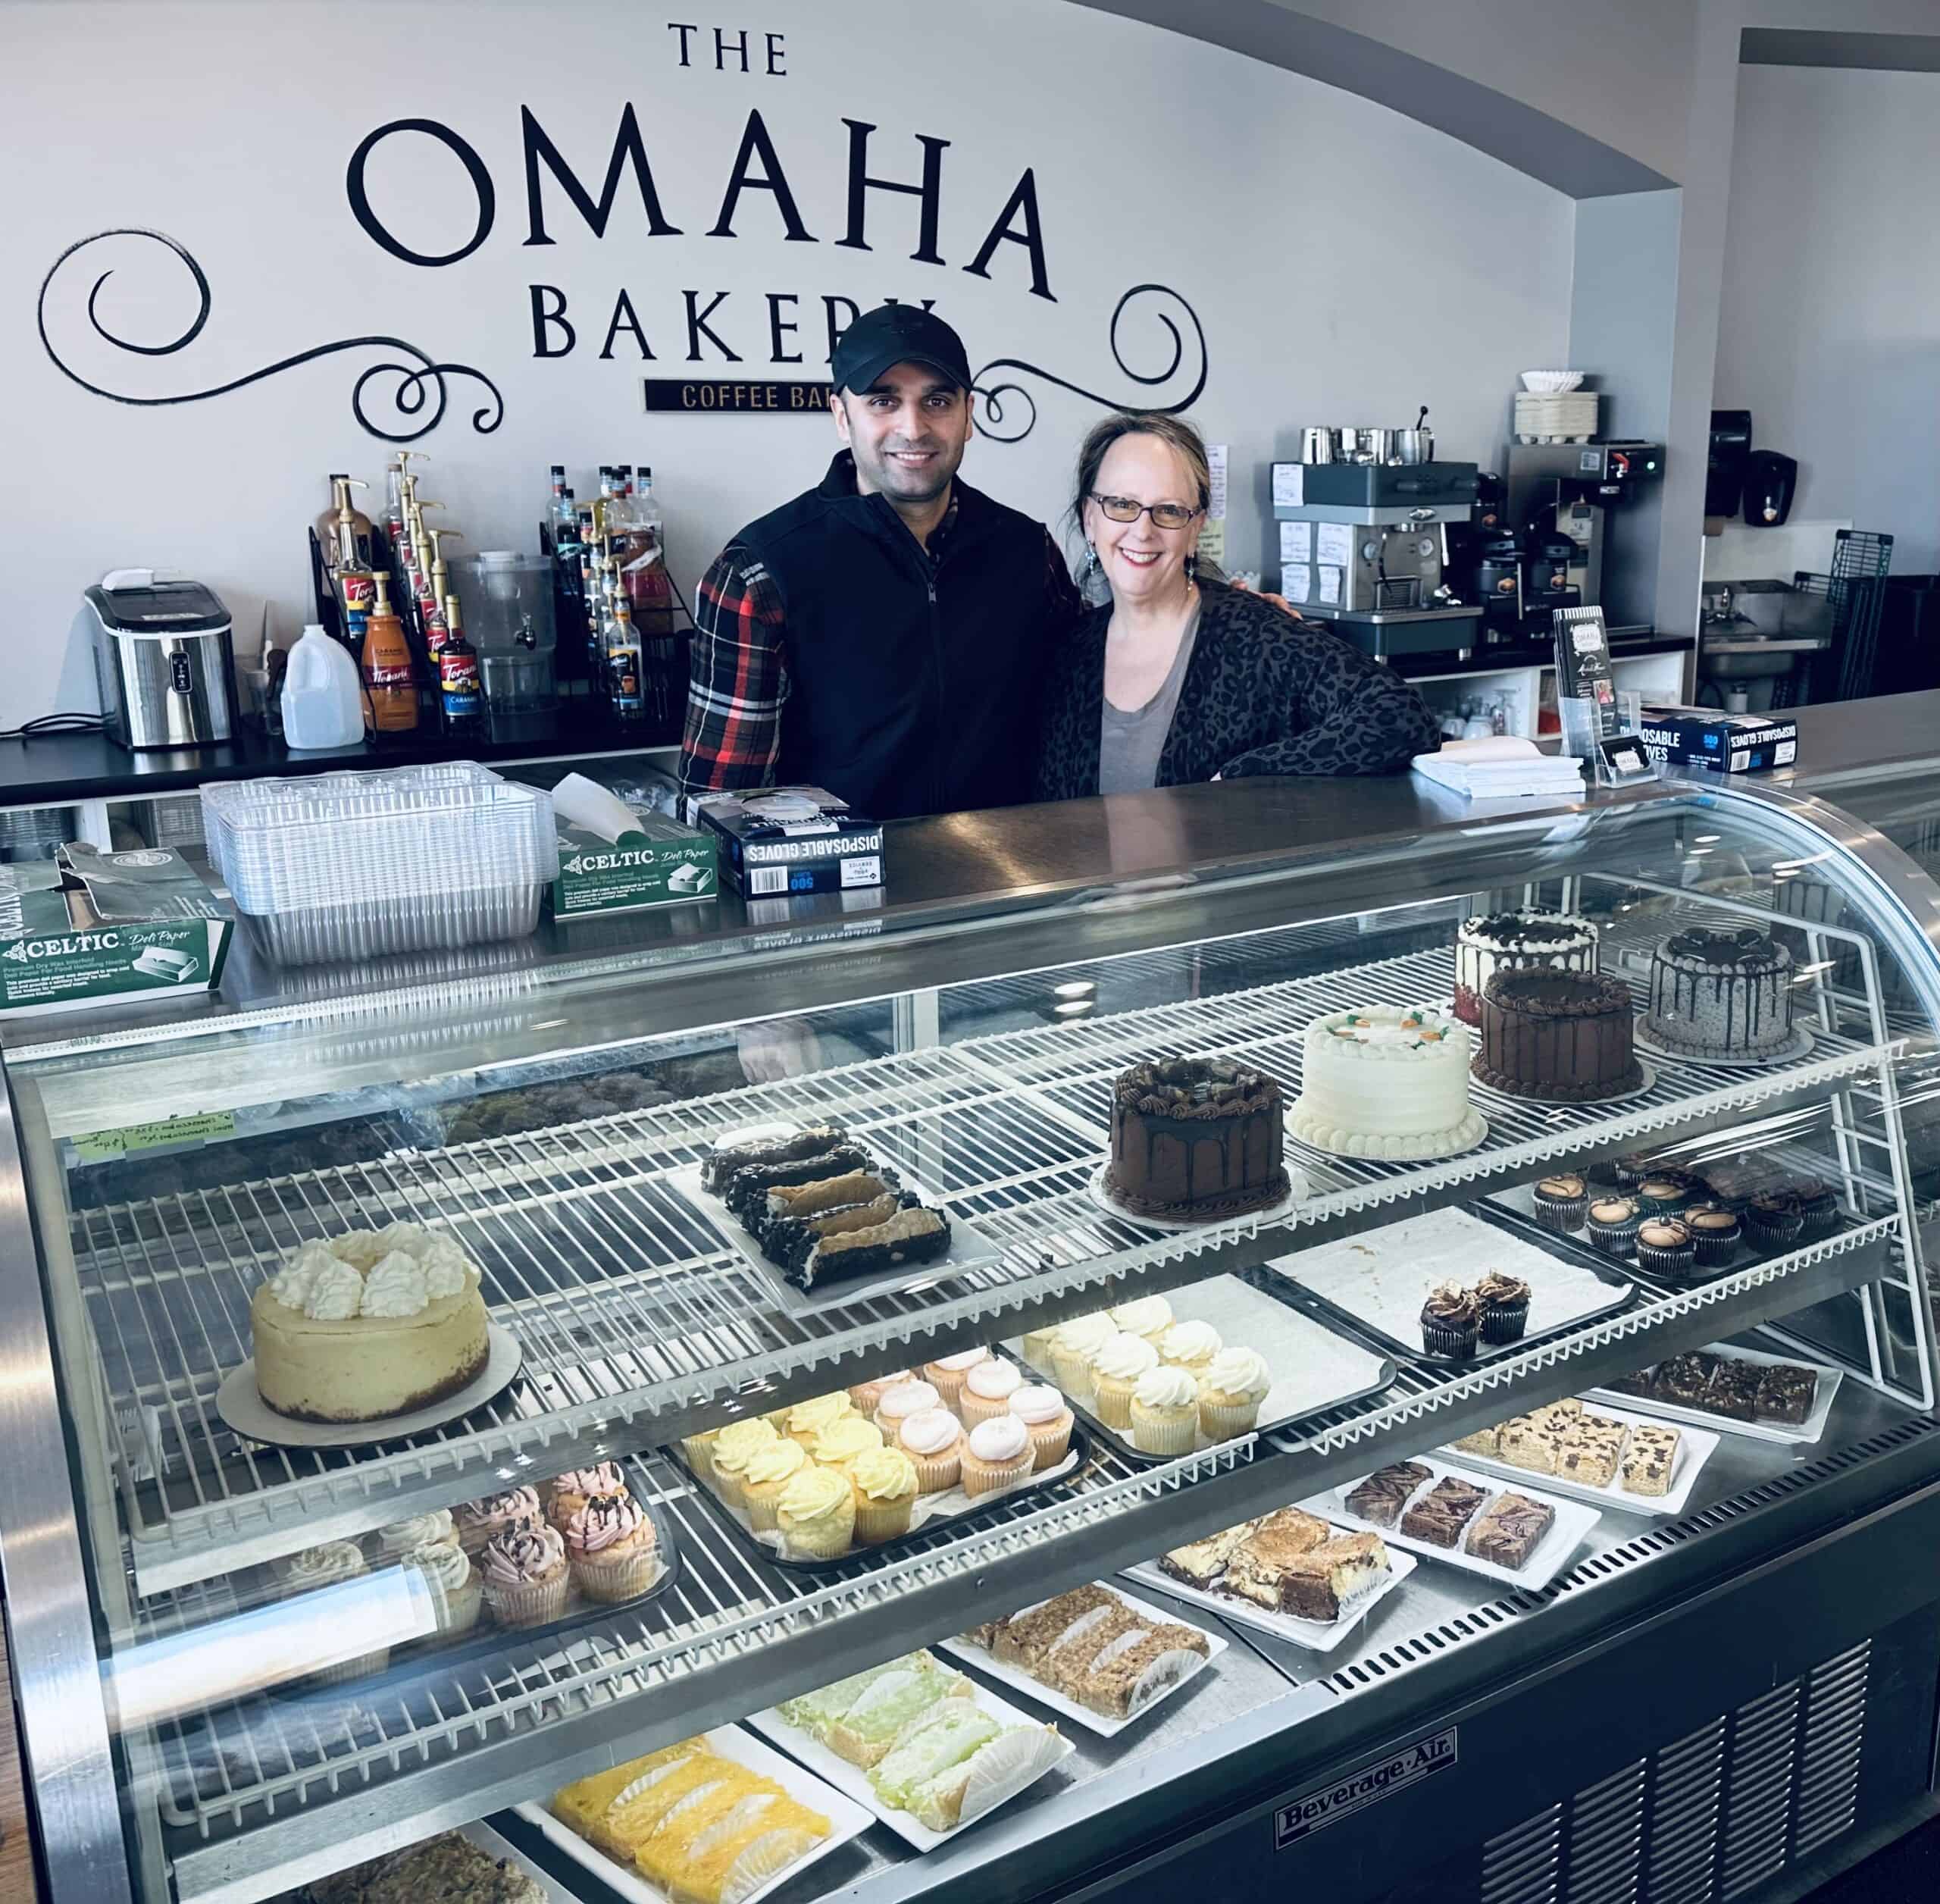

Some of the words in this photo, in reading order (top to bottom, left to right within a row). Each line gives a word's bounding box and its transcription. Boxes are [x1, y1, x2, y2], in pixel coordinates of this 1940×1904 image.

[668, 23, 788, 77] THE
[346, 101, 1059, 303] OMAHA
[528, 283, 936, 364] BAKER
[682, 384, 778, 408] COFFEE
[350, 581, 374, 601] Tora
[749, 841, 799, 862] GLOVES
[801, 835, 879, 856] DISPOSABLE
[582, 849, 655, 872] CELTIC
[790, 877, 813, 891] 500
[27, 932, 120, 958] CELTIC
[129, 932, 156, 946] Deli
[157, 930, 190, 946] Paper
